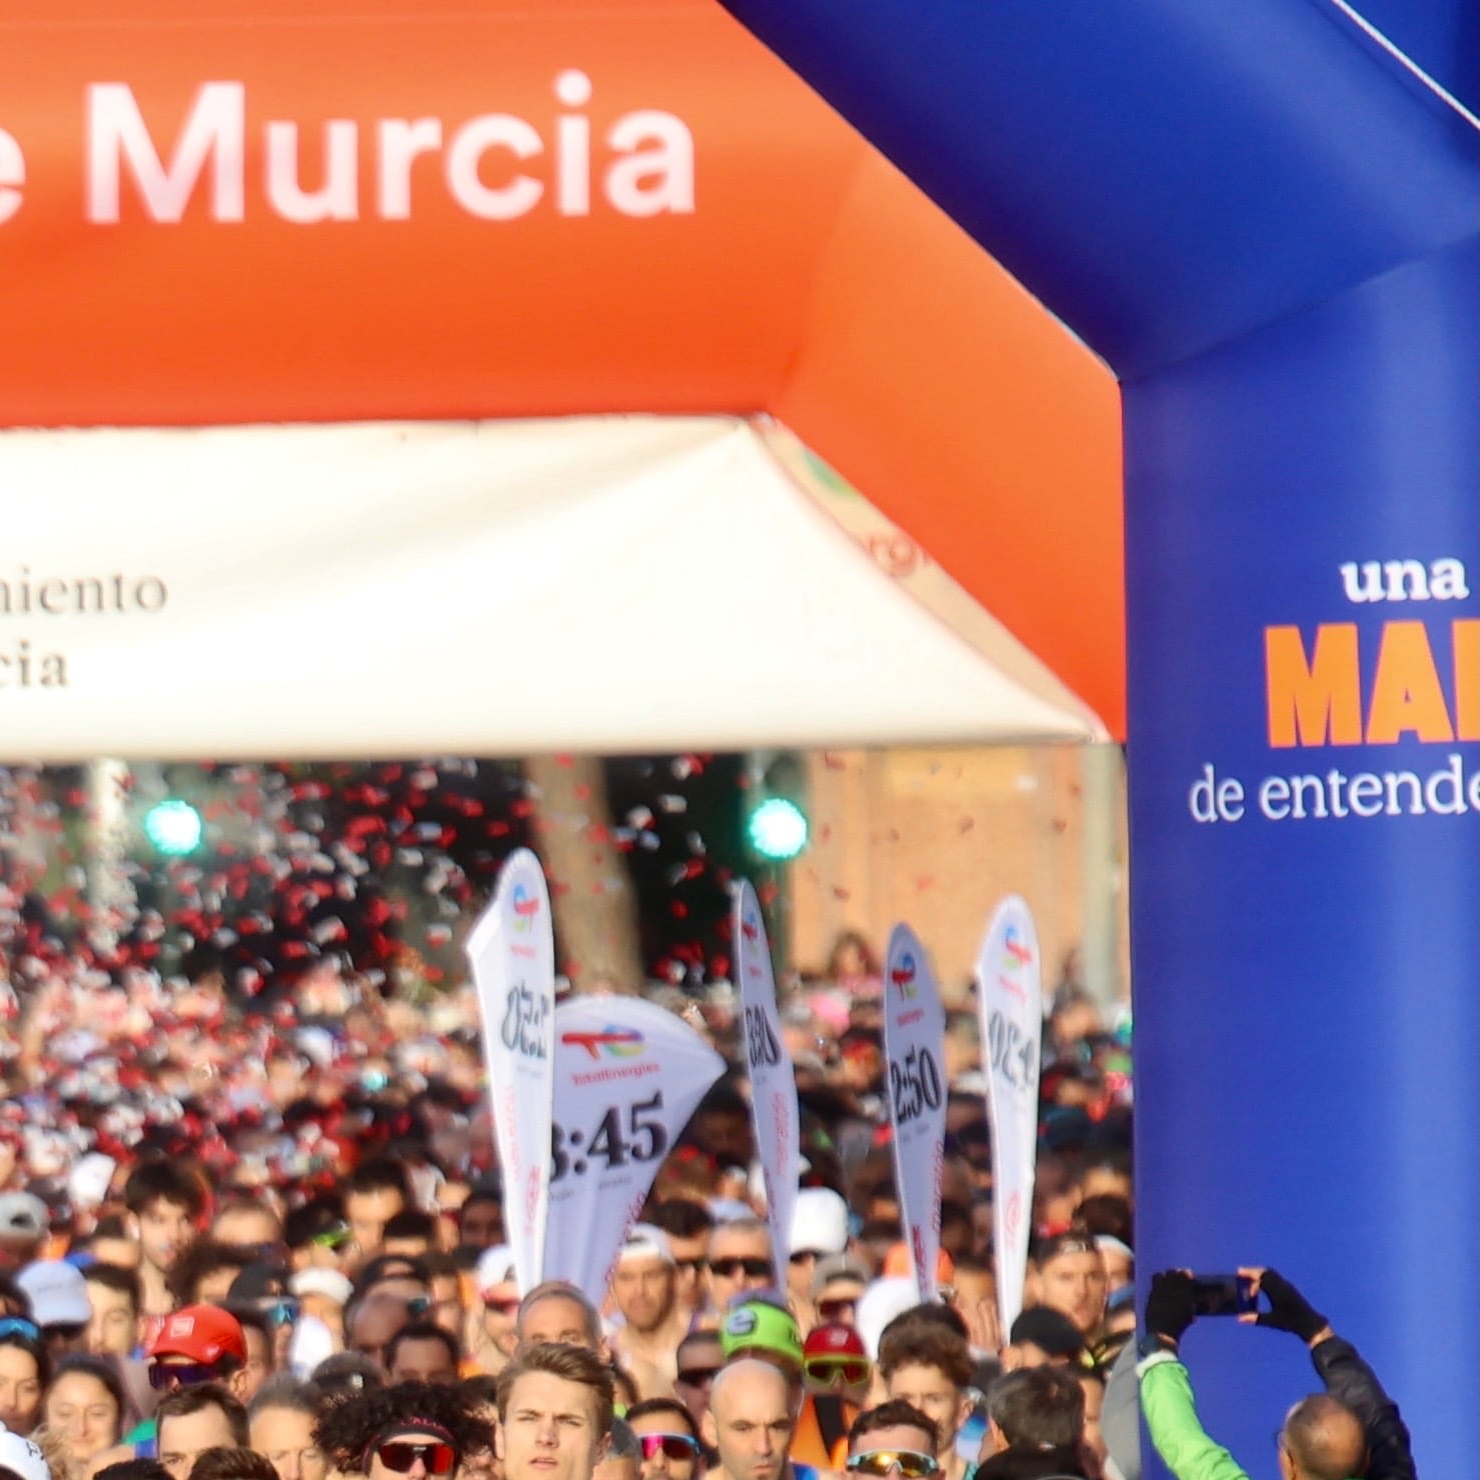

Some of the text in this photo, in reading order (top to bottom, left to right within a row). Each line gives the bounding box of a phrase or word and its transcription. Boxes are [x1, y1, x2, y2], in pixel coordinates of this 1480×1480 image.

[87, 70, 698, 223] Murcia
[1340, 557, 1470, 603] una
[1190, 763, 1245, 823] de
